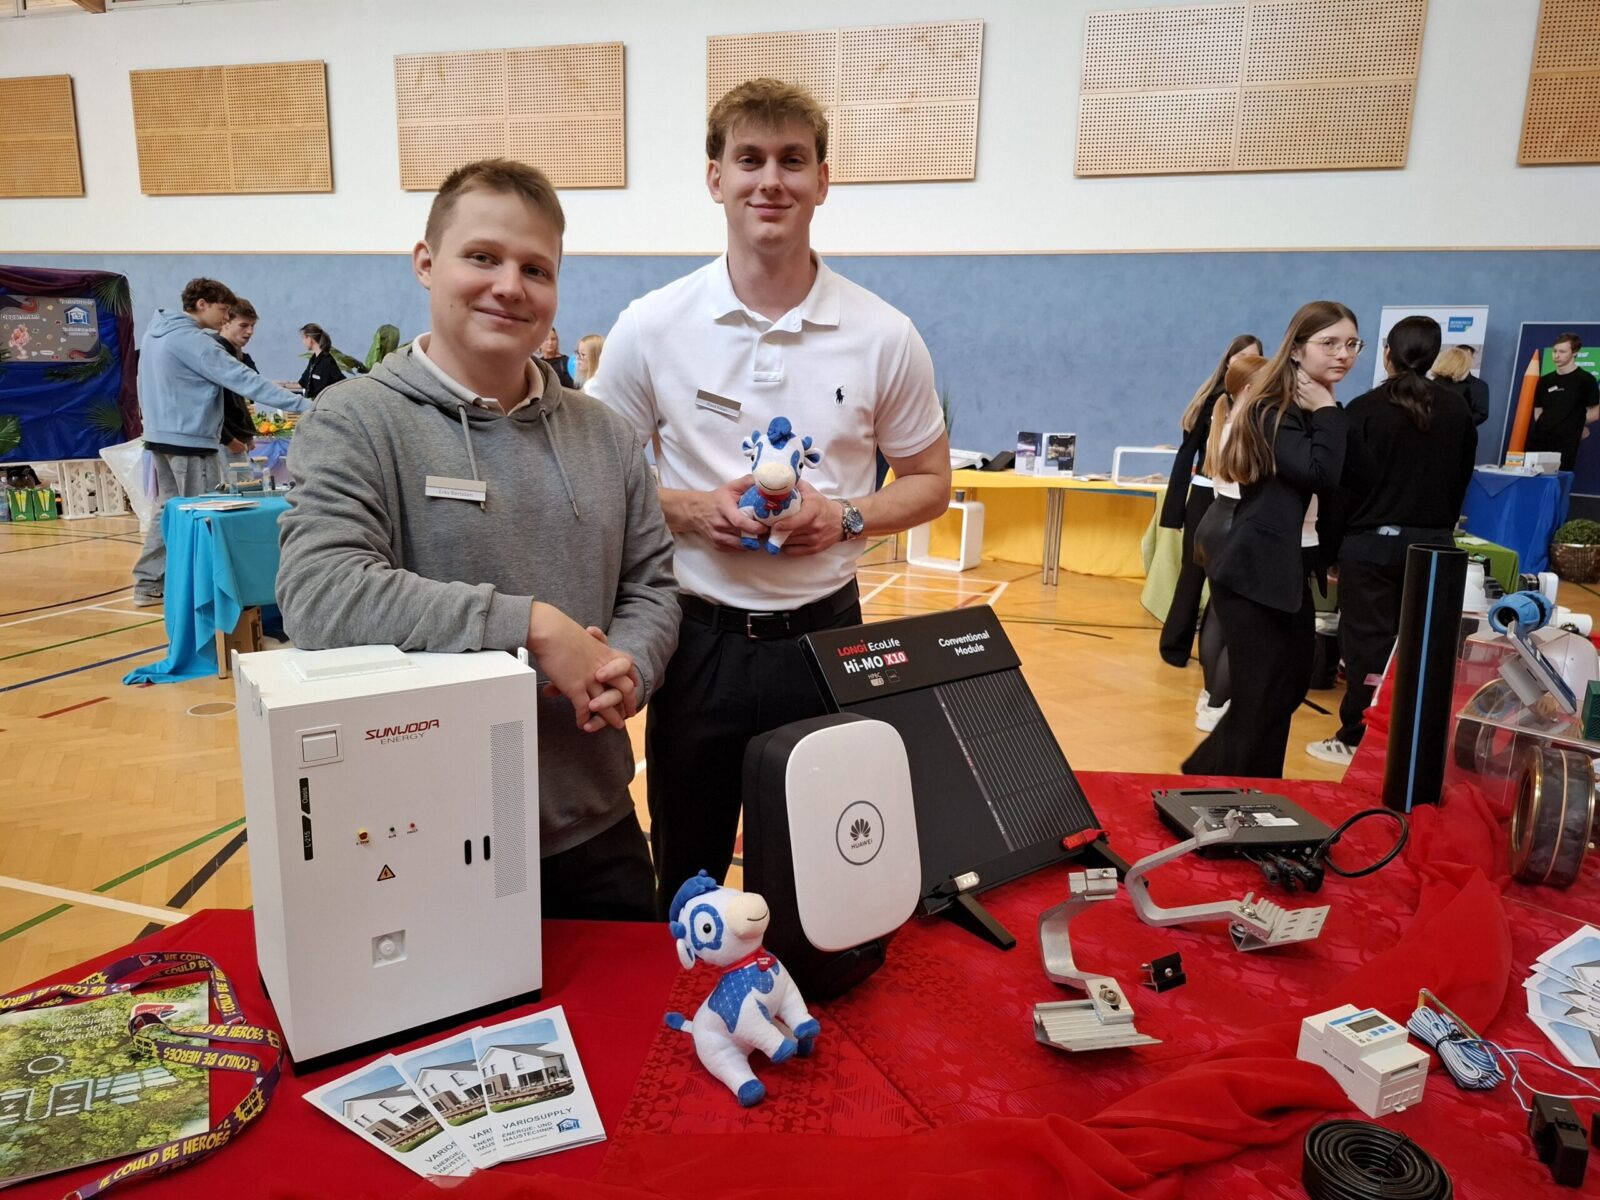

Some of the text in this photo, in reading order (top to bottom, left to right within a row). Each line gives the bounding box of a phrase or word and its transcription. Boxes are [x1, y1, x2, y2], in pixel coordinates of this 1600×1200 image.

[938, 630, 990, 647] Conventional
[837, 638, 900, 657] LONGi EcoLife
[954, 643, 985, 656] Module
[843, 652, 907, 674] Hi-MO X10
[364, 719, 440, 741] SUNWODA
[380, 732, 427, 745] ENERGY
[851, 838, 873, 849] HUAWEI
[164, 959, 211, 976] COULD BE
[89, 985, 108, 996] WE
[215, 1025, 229, 1037] BE
[228, 1025, 264, 1041] HEROES
[163, 1047, 202, 1065] HEROES
[200, 1052, 218, 1066] BE
[217, 1053, 250, 1071] COULD
[502, 1107, 572, 1129] VARIOSUPPLY
[502, 1126, 554, 1143] HAUSTECHNIK
[113, 1152, 159, 1180] COULD
[162, 1143, 180, 1163] BE
[182, 1130, 231, 1154] HEROES
